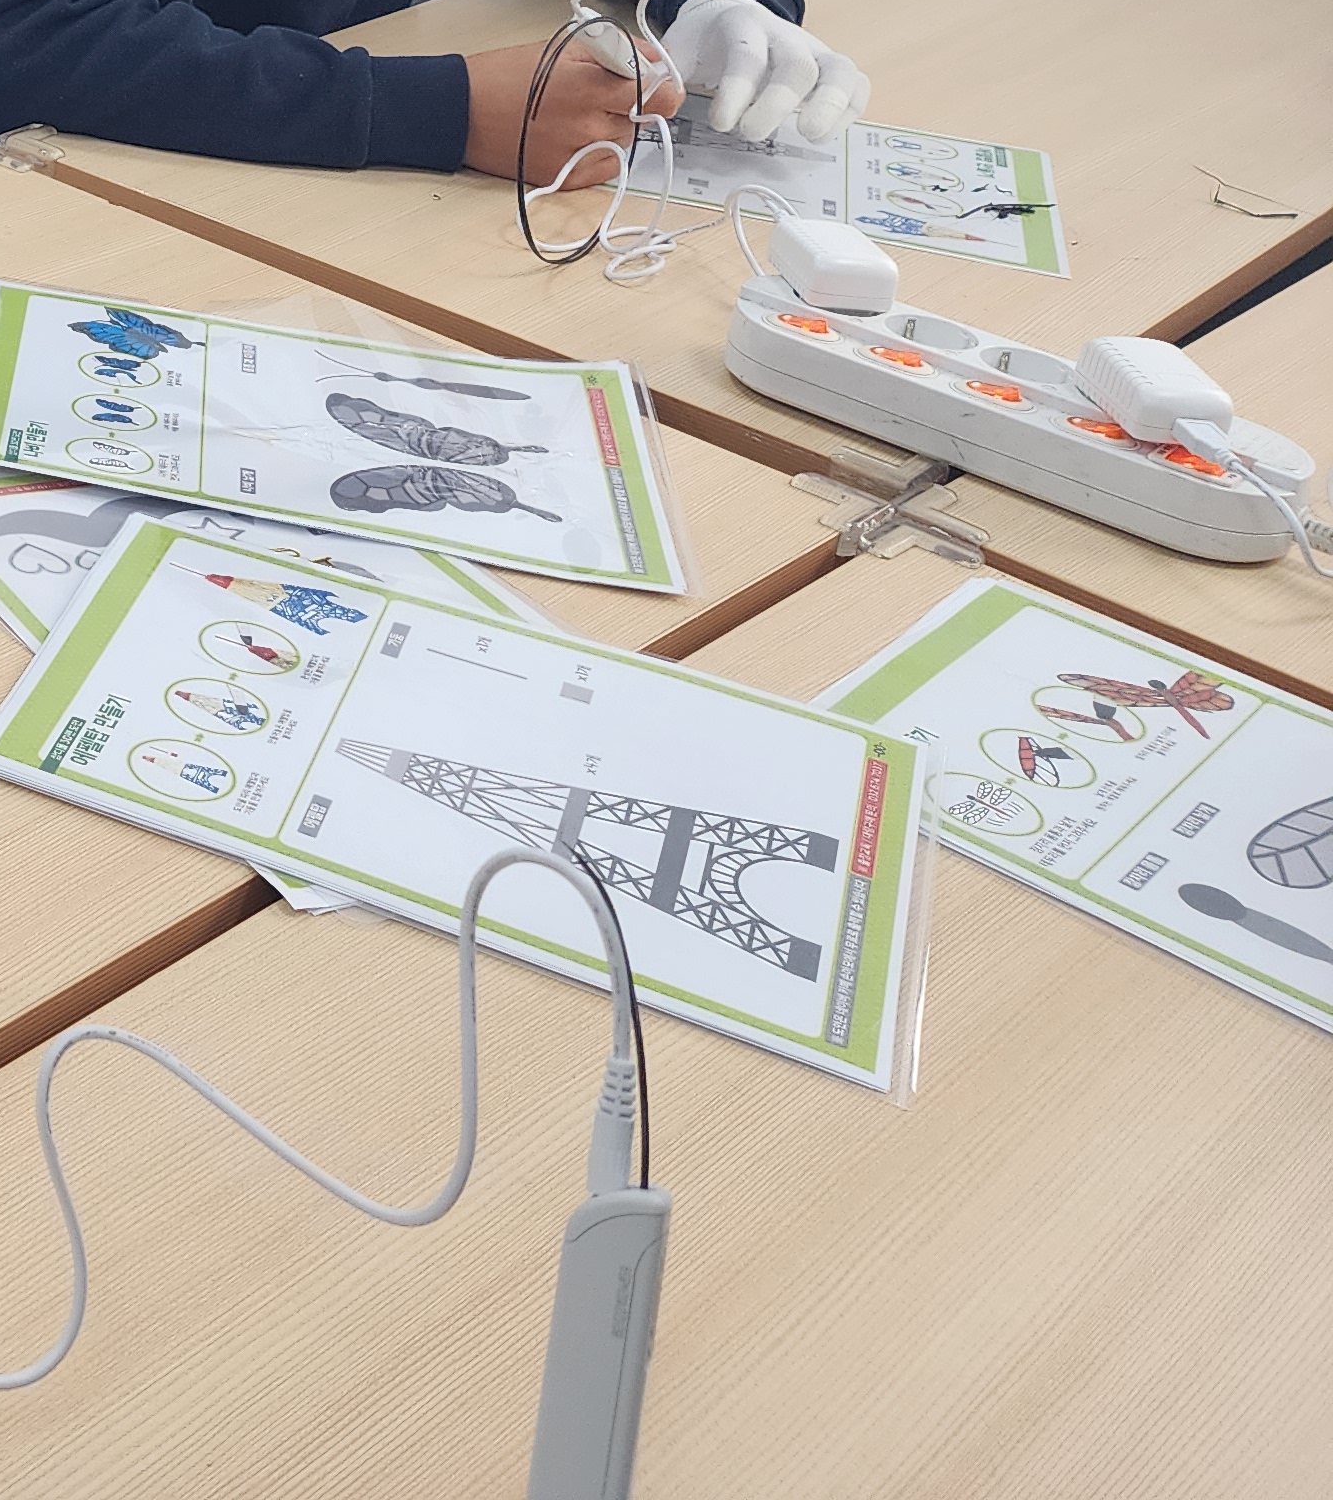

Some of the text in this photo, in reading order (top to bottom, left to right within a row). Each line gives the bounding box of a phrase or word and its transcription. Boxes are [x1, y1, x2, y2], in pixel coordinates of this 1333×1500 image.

[21, 420, 48, 458] 나비 만들기
[386, 632, 405, 647] 기둥
[67, 693, 132, 767] 에펠탑 만들기
